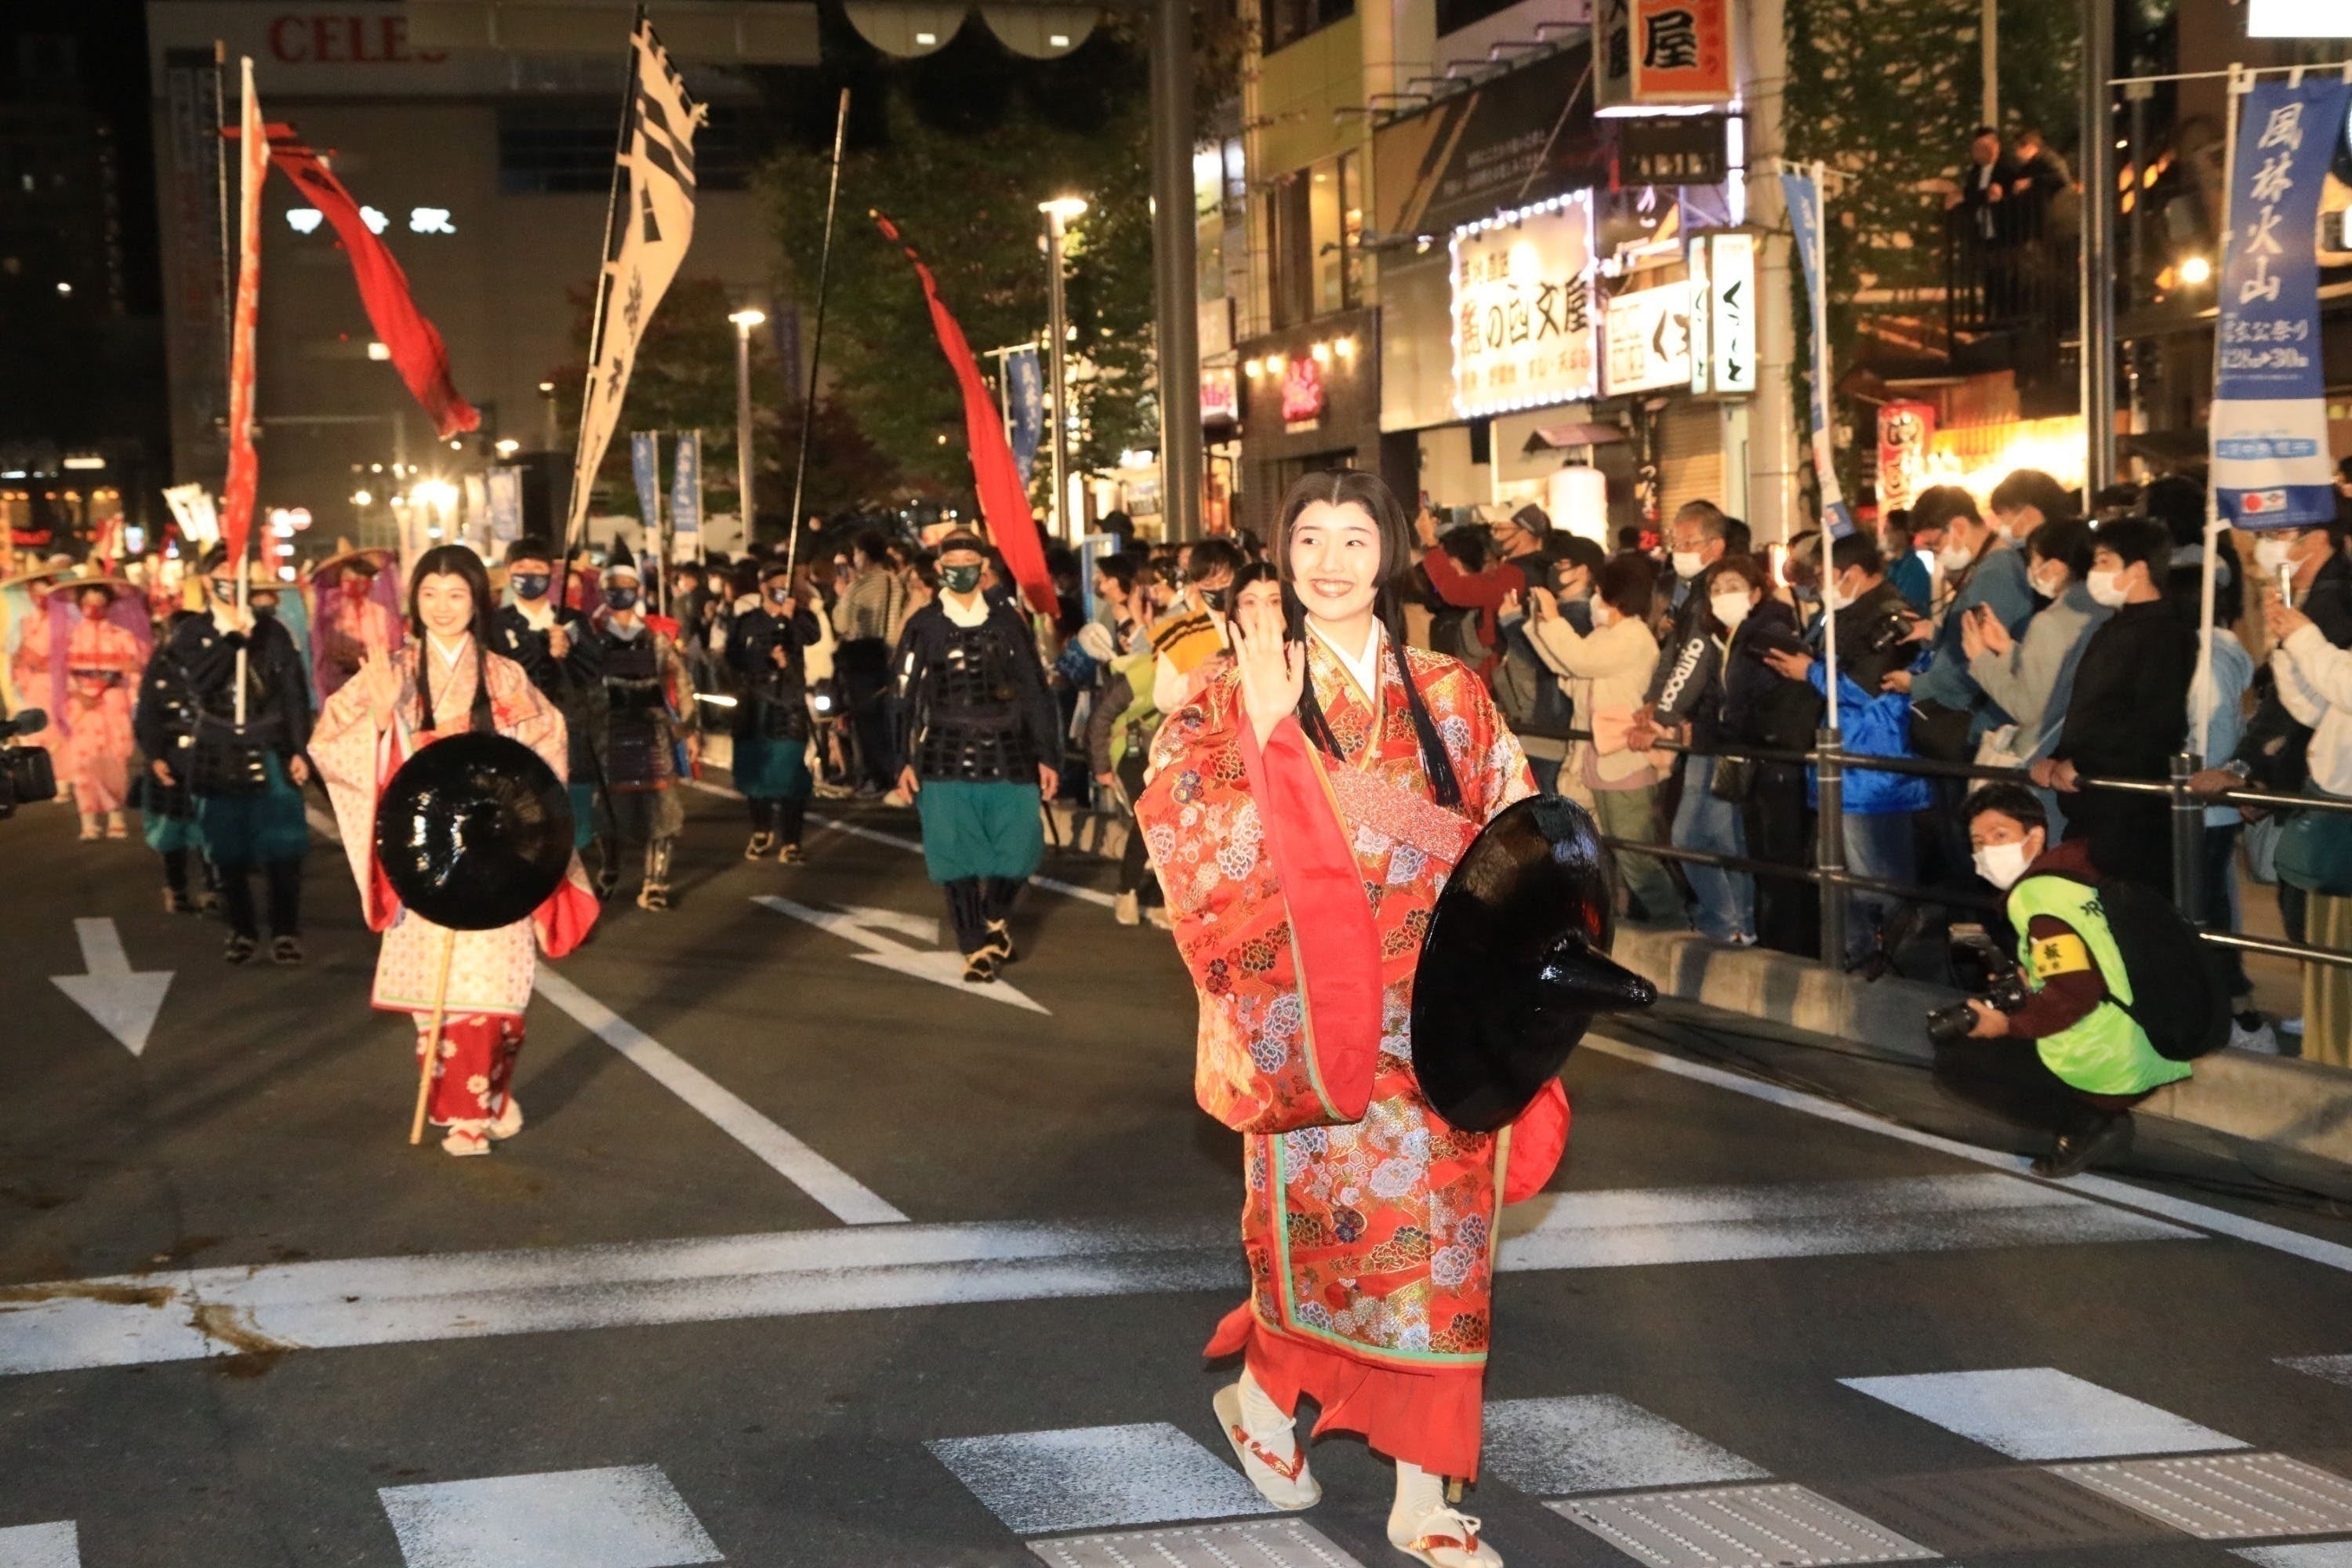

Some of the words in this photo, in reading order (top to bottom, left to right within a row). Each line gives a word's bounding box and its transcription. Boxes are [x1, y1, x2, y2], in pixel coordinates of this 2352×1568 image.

[267, 16, 449, 64] CELE
[2238, 102, 2304, 305] 風林火山
[1657, 637, 1705, 712] OUTDOOR
